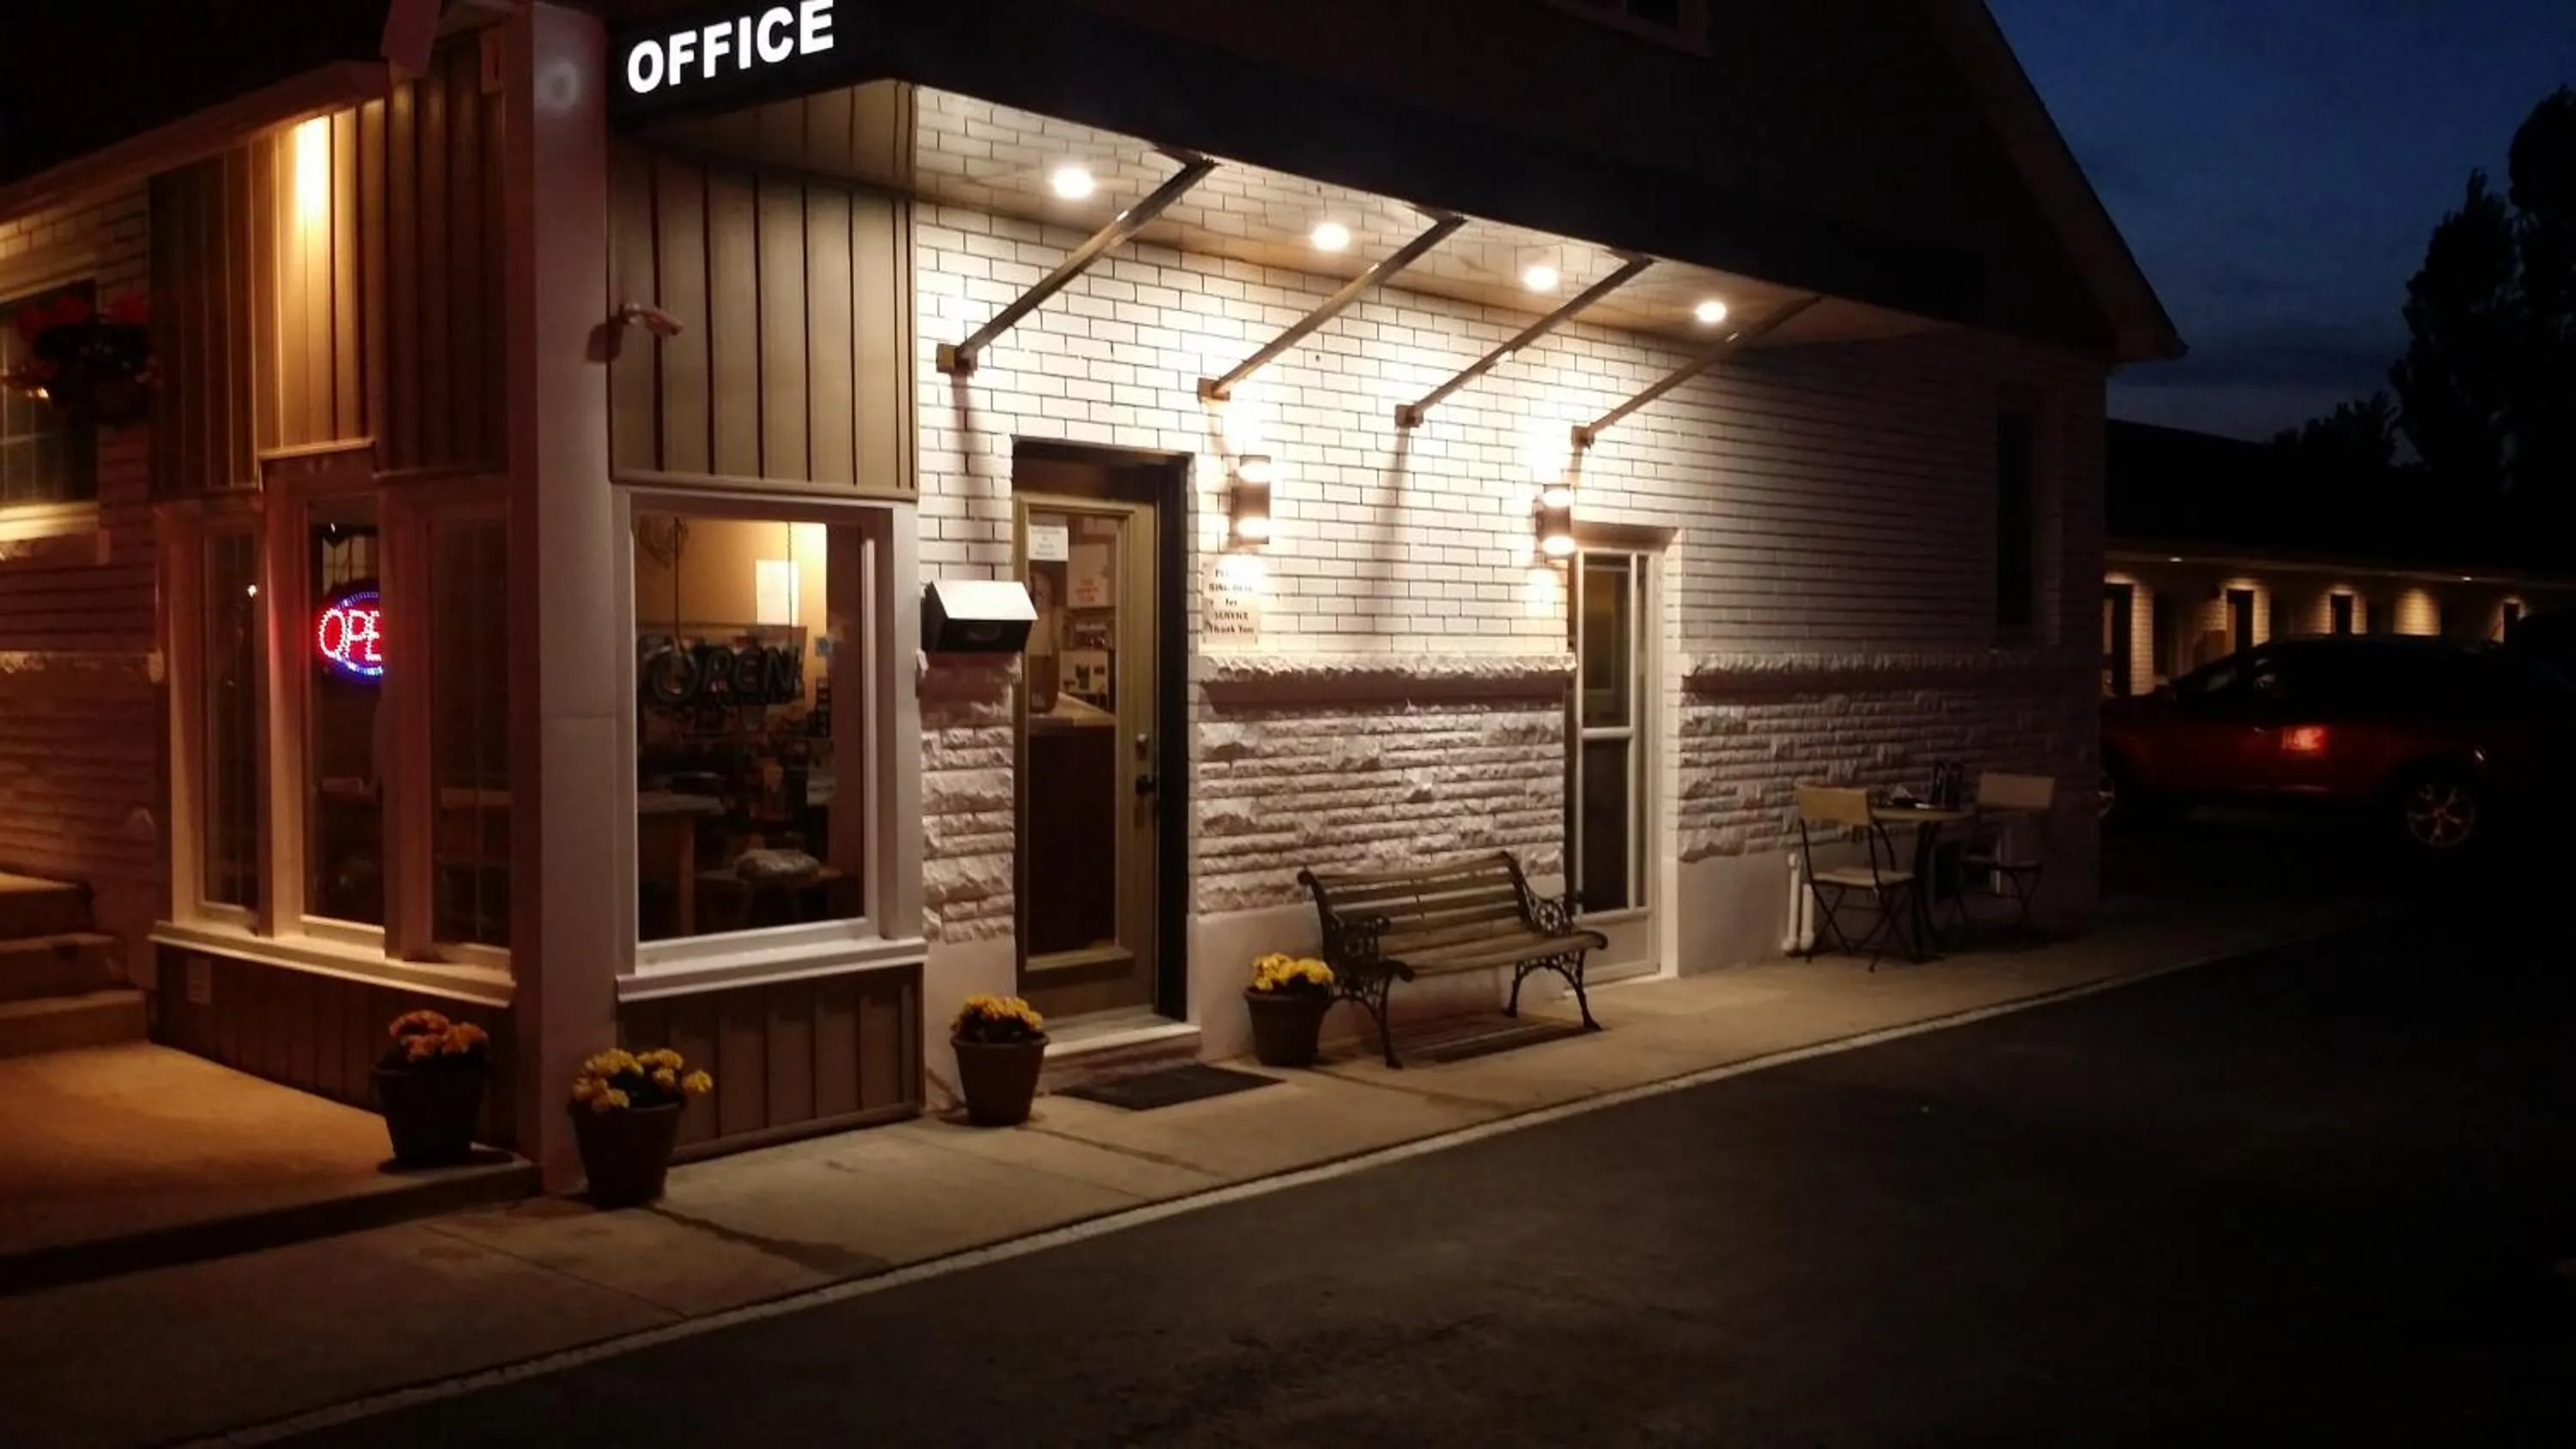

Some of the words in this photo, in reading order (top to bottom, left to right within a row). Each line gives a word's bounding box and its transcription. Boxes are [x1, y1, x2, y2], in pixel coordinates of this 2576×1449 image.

[627, 0, 834, 94] OFFICE
[318, 607, 382, 662] OPE
[649, 645, 800, 704] OPEN
